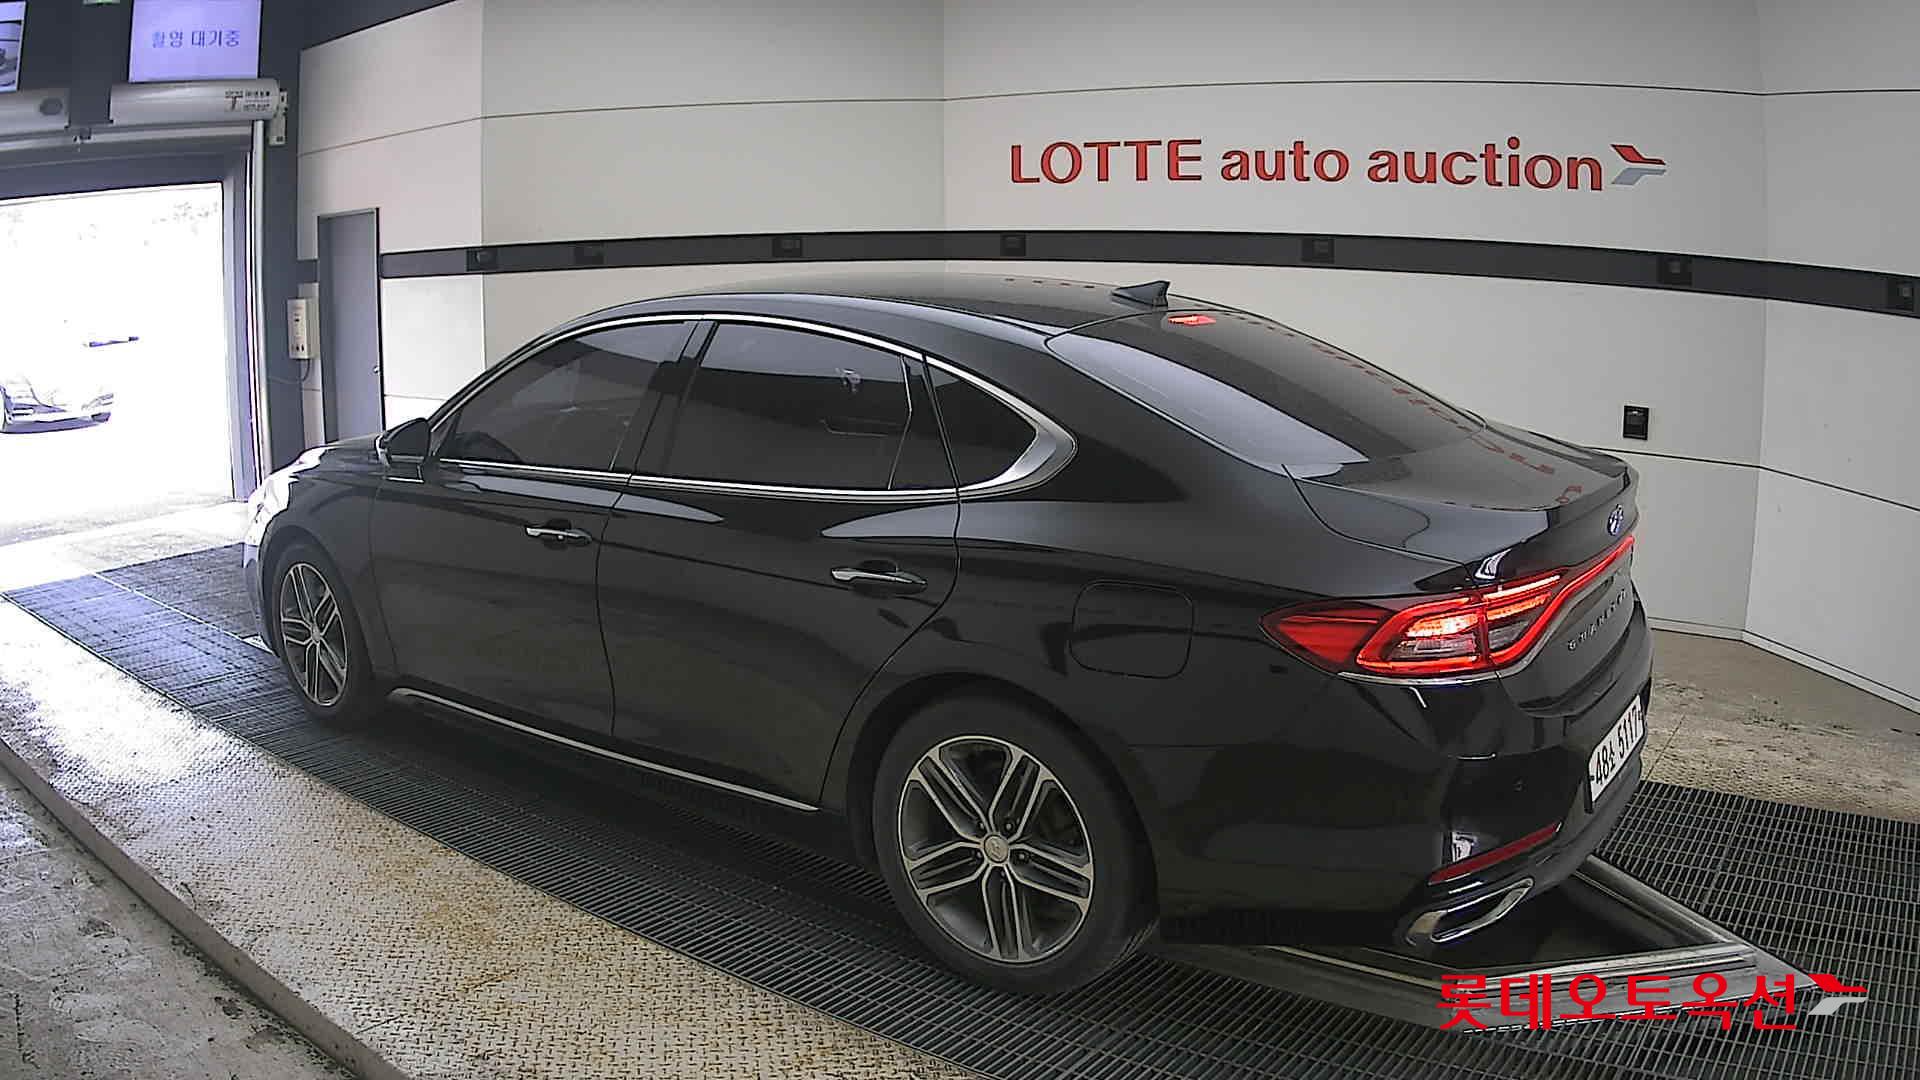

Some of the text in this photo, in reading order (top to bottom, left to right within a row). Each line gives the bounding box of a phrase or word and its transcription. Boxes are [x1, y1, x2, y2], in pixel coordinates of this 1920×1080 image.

[191, 31, 240, 47] 대기중
[1011, 136, 1603, 191] LOTTE auto auction
[1617, 704, 1638, 759] 5117
